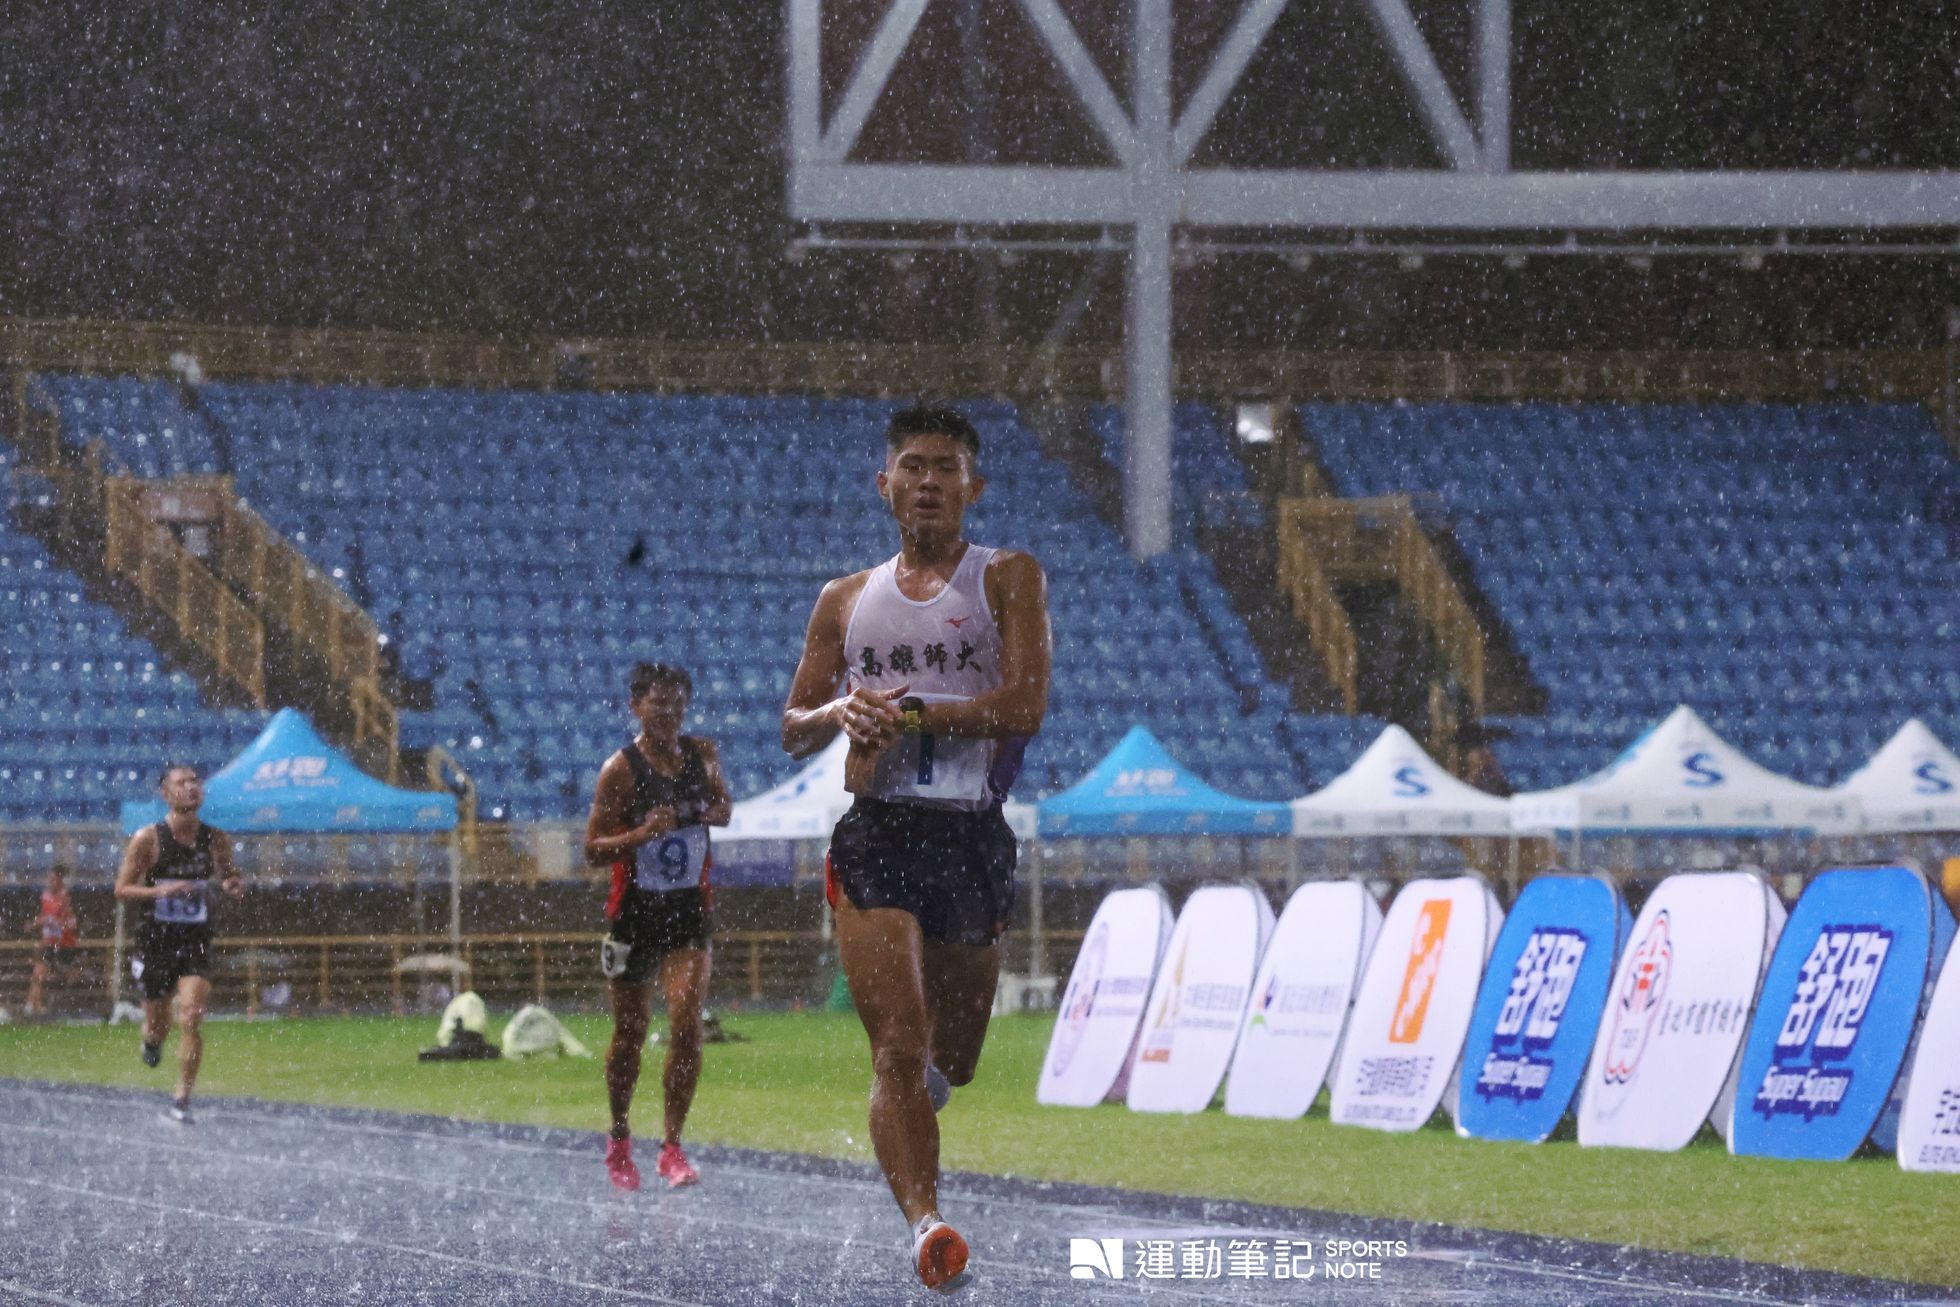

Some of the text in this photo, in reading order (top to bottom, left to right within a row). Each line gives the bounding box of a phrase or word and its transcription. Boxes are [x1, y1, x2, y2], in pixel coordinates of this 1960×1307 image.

[860, 640, 982, 677] 高雄師大
[659, 838, 688, 882] 9
[1494, 932, 1588, 1039] 舒跑
[1775, 930, 1893, 1047] 舒跑
